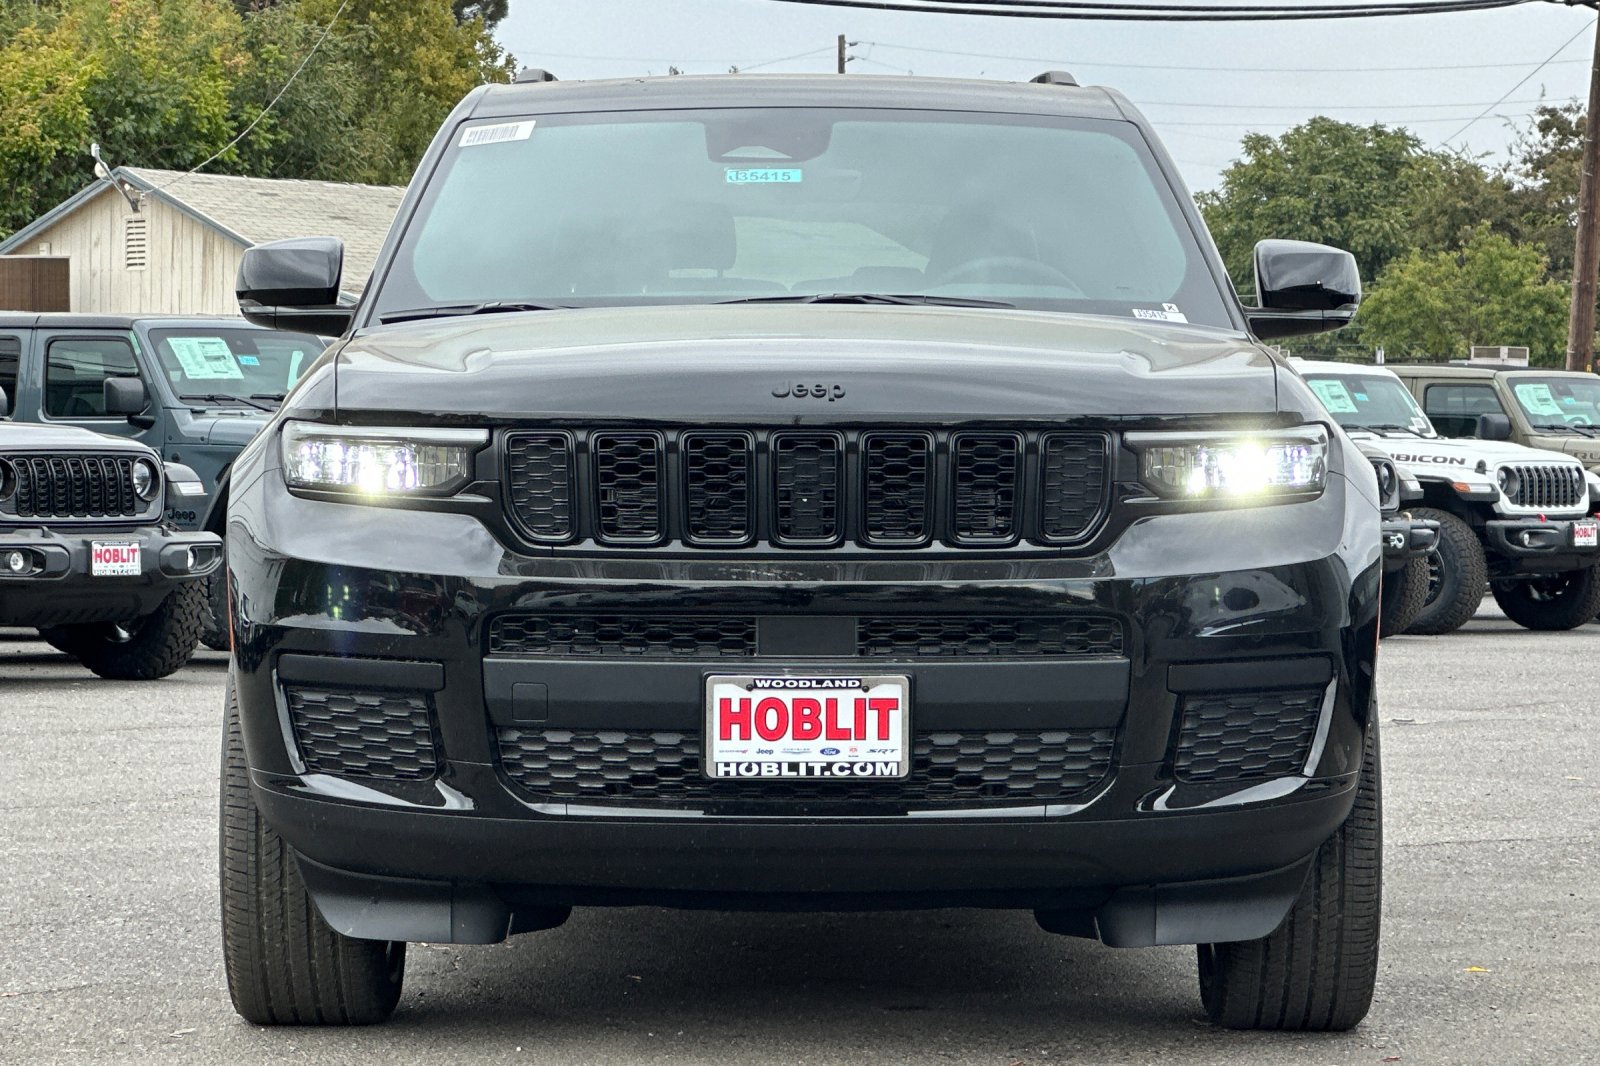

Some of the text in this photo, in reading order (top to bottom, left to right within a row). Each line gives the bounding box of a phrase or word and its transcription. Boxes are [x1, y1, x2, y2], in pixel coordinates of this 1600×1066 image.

[728, 170, 791, 181] J35415
[771, 381, 846, 402] Jeep
[1390, 453, 1466, 466] BICON
[168, 507, 196, 522] Jeep
[94, 548, 138, 564] HOBLIT
[754, 679, 861, 688] WOODLAND
[719, 697, 899, 742] HOBLIT
[717, 761, 898, 776] HOBLIT.COM
